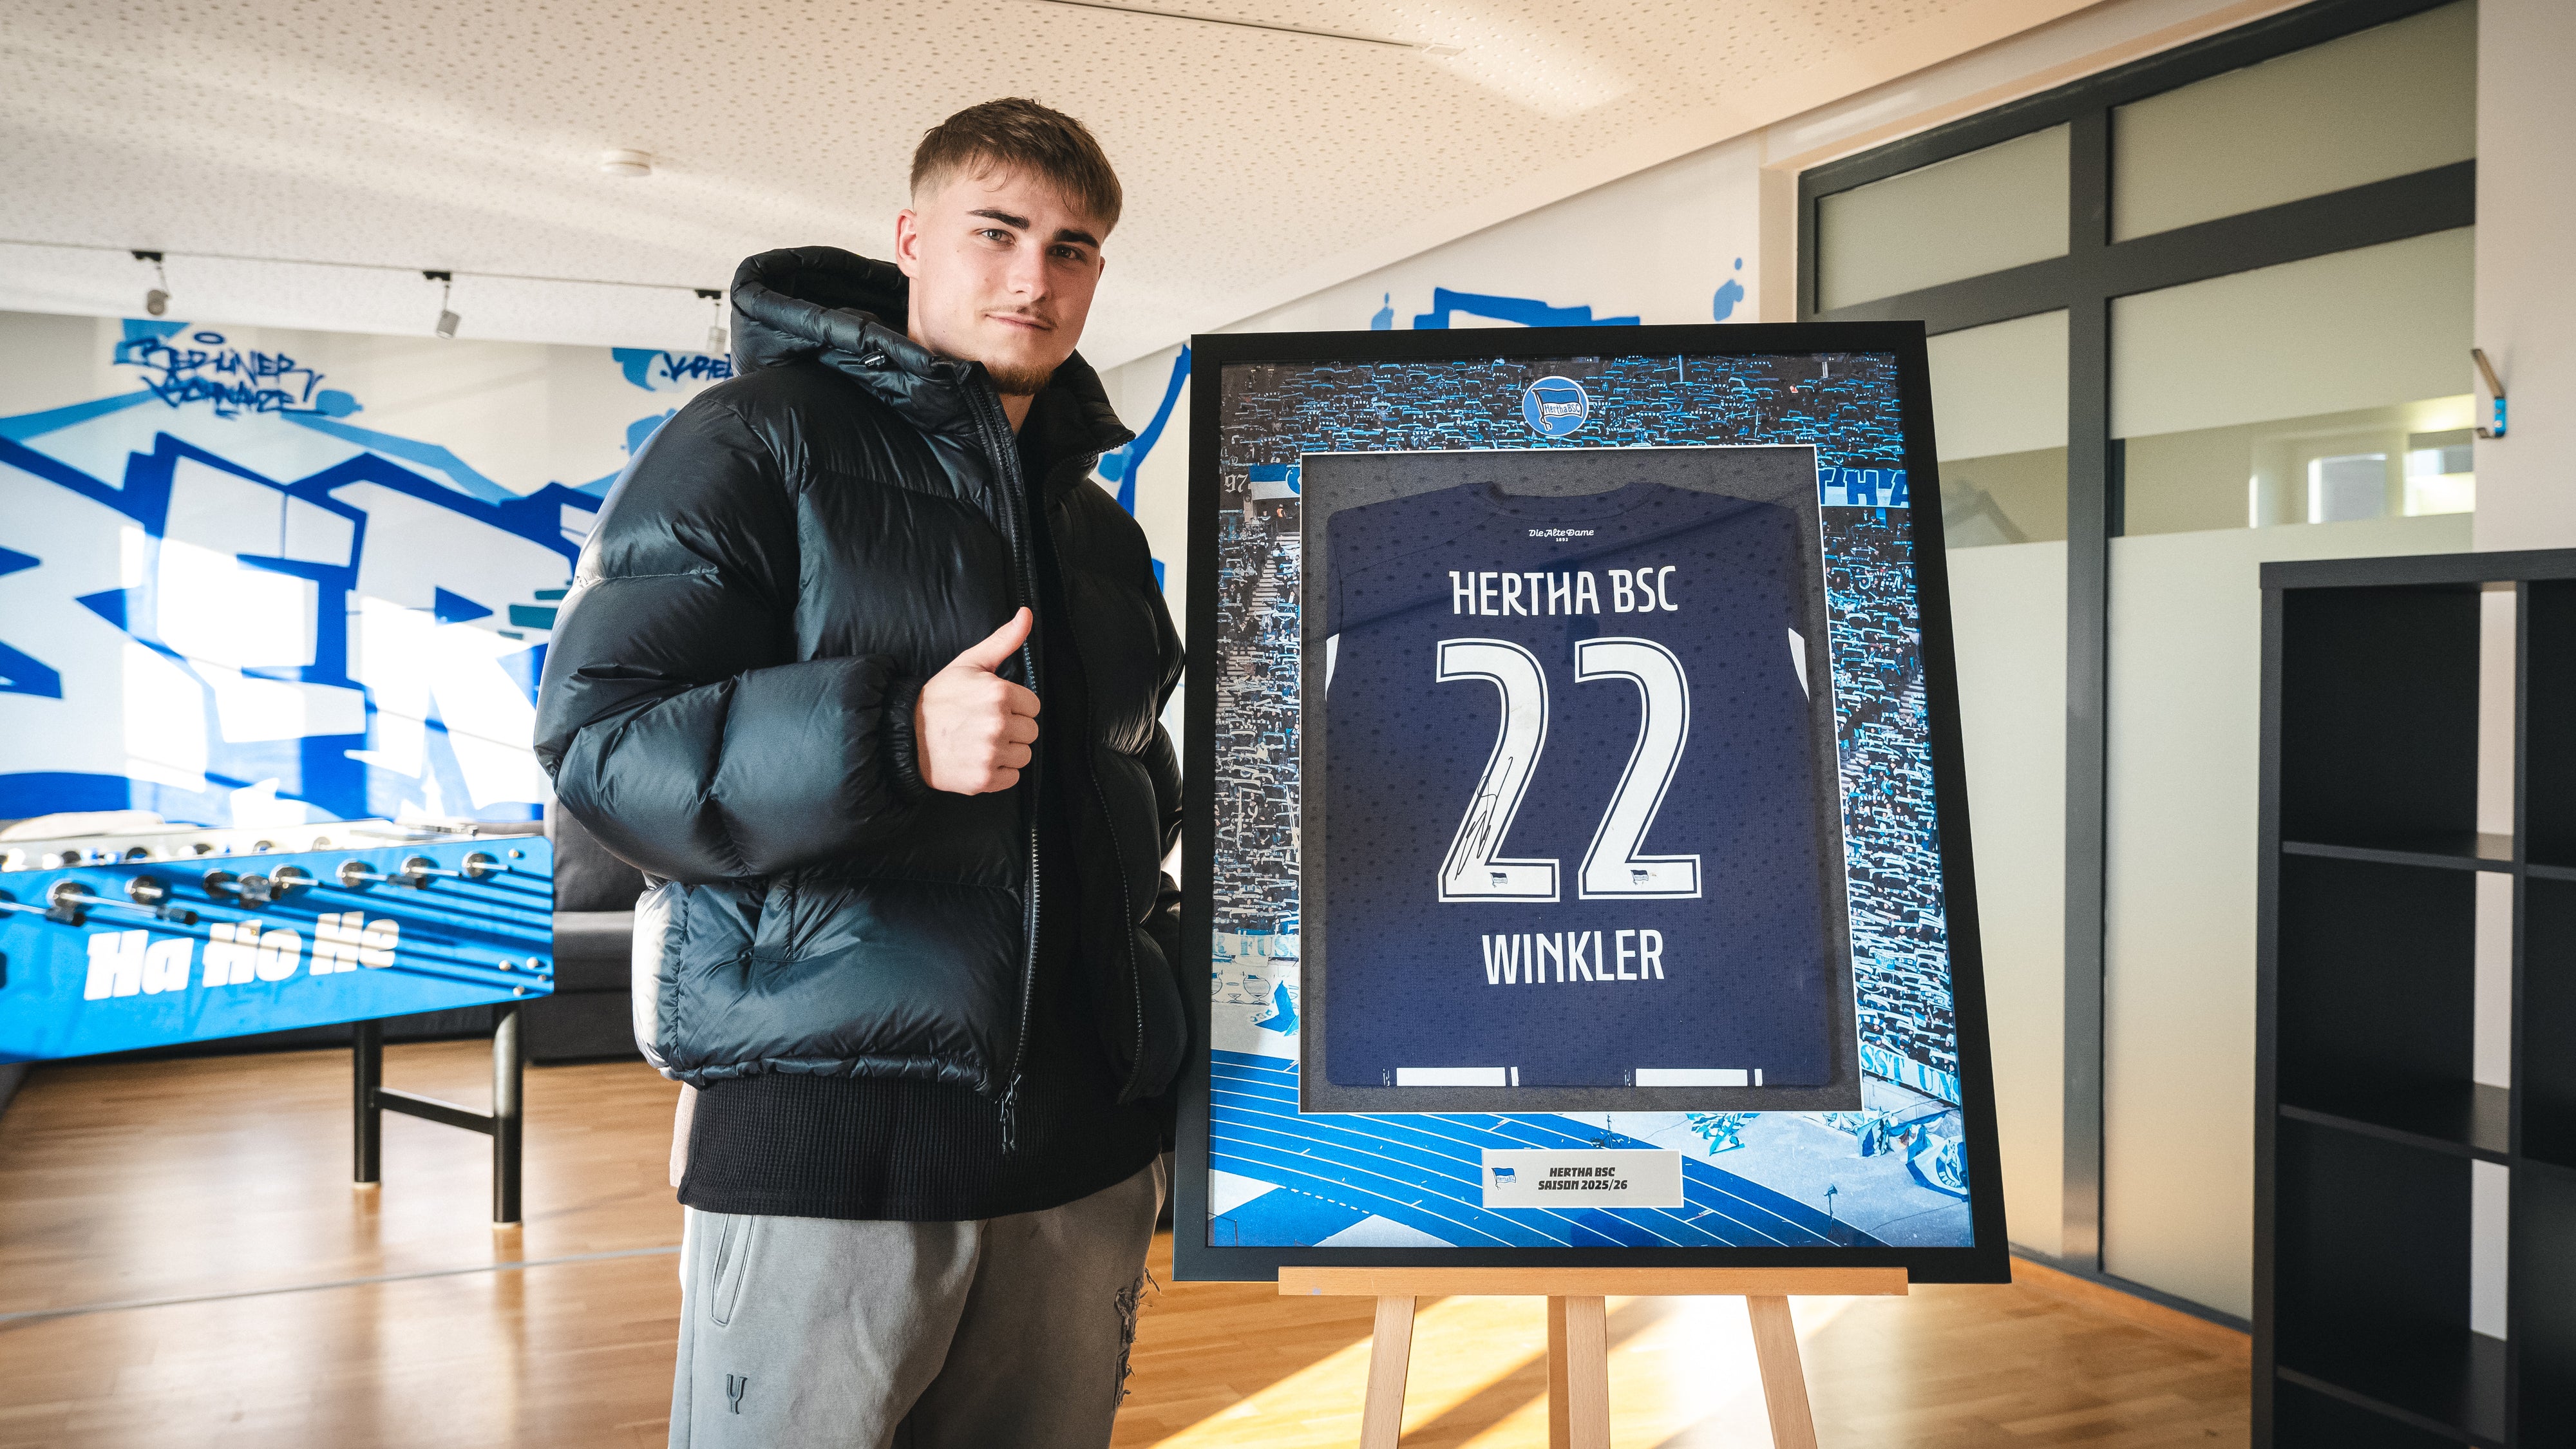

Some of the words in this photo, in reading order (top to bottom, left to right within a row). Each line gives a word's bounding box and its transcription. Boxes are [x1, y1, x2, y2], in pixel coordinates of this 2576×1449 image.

[1544, 529, 1566, 537] Alte
[1449, 571, 1600, 616] HERTHA
[1608, 565, 1678, 613] BSC
[1436, 637, 1701, 902] 22
[84, 929, 194, 1001] Ha
[202, 920, 303, 988] Ho
[309, 911, 400, 976] He
[1482, 929, 1665, 985] WINKLER
[1538, 1180, 1579, 1190] SAISON
[1581, 1179, 1627, 1191] 2025/26
[1549, 1168, 1593, 1177] HERTHA
[1595, 1167, 1615, 1177] BSC
